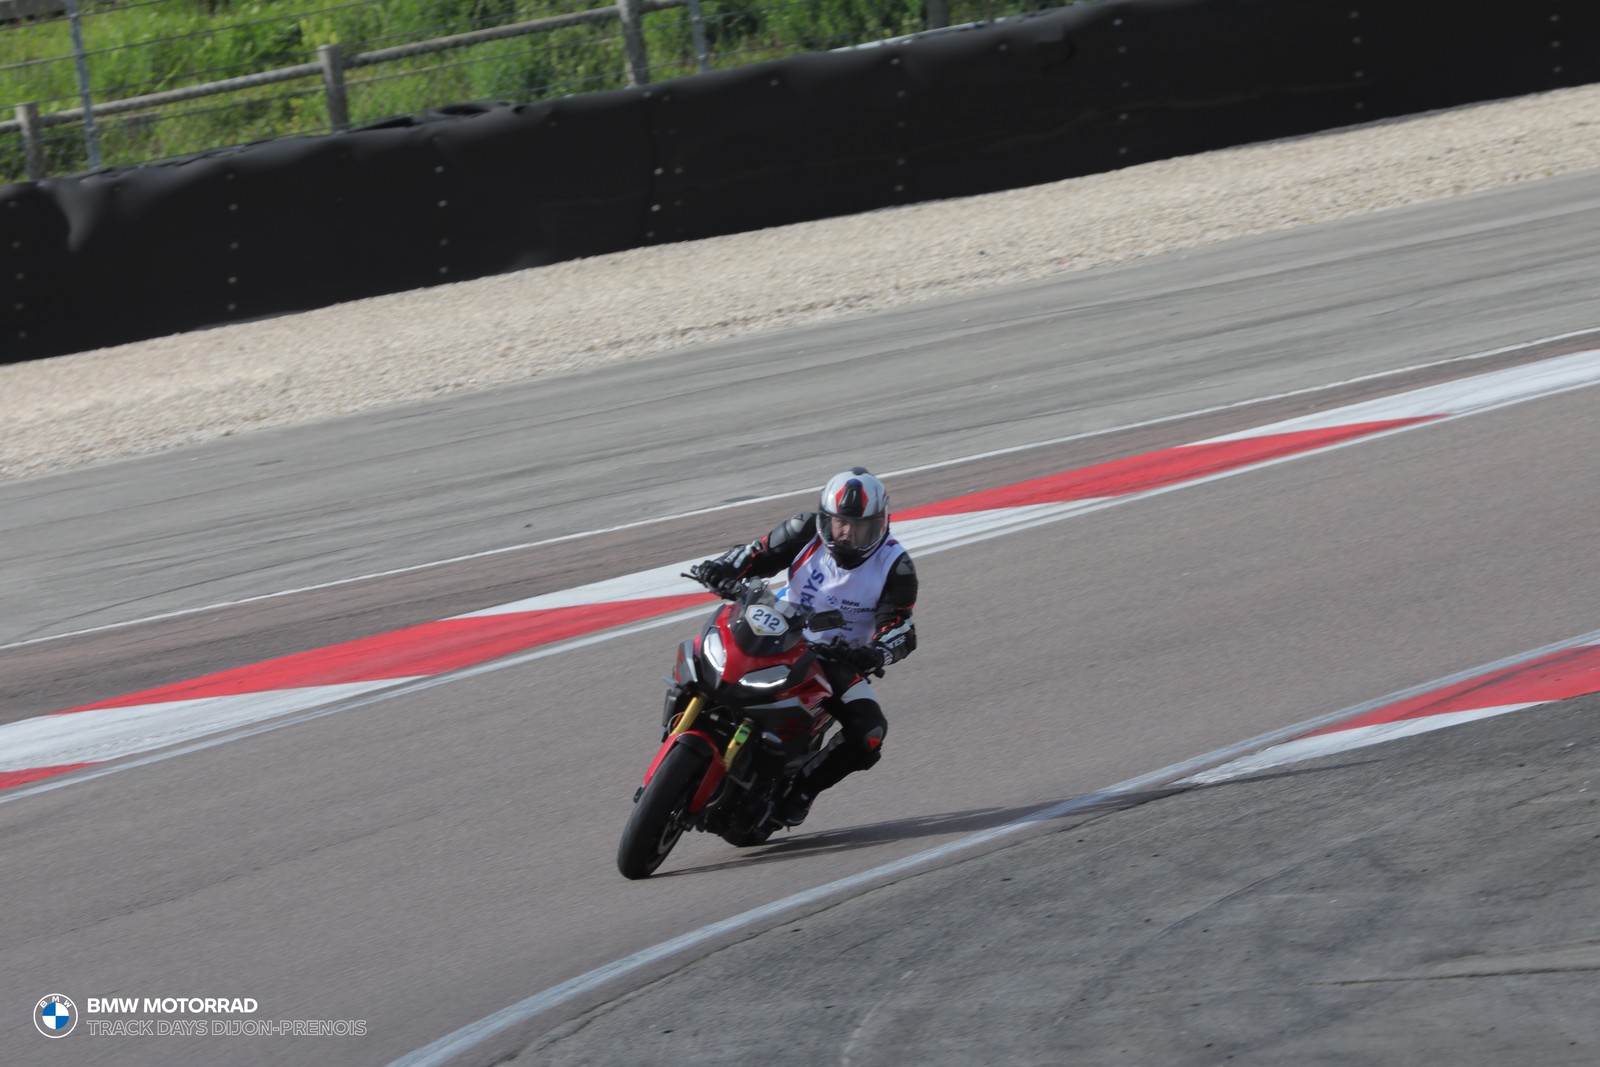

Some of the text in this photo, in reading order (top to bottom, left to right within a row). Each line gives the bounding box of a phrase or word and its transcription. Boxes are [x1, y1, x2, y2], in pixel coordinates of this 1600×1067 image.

[841, 598, 860, 608] BMW
[839, 605, 877, 614] MOTORRA
[752, 608, 780, 631] 212
